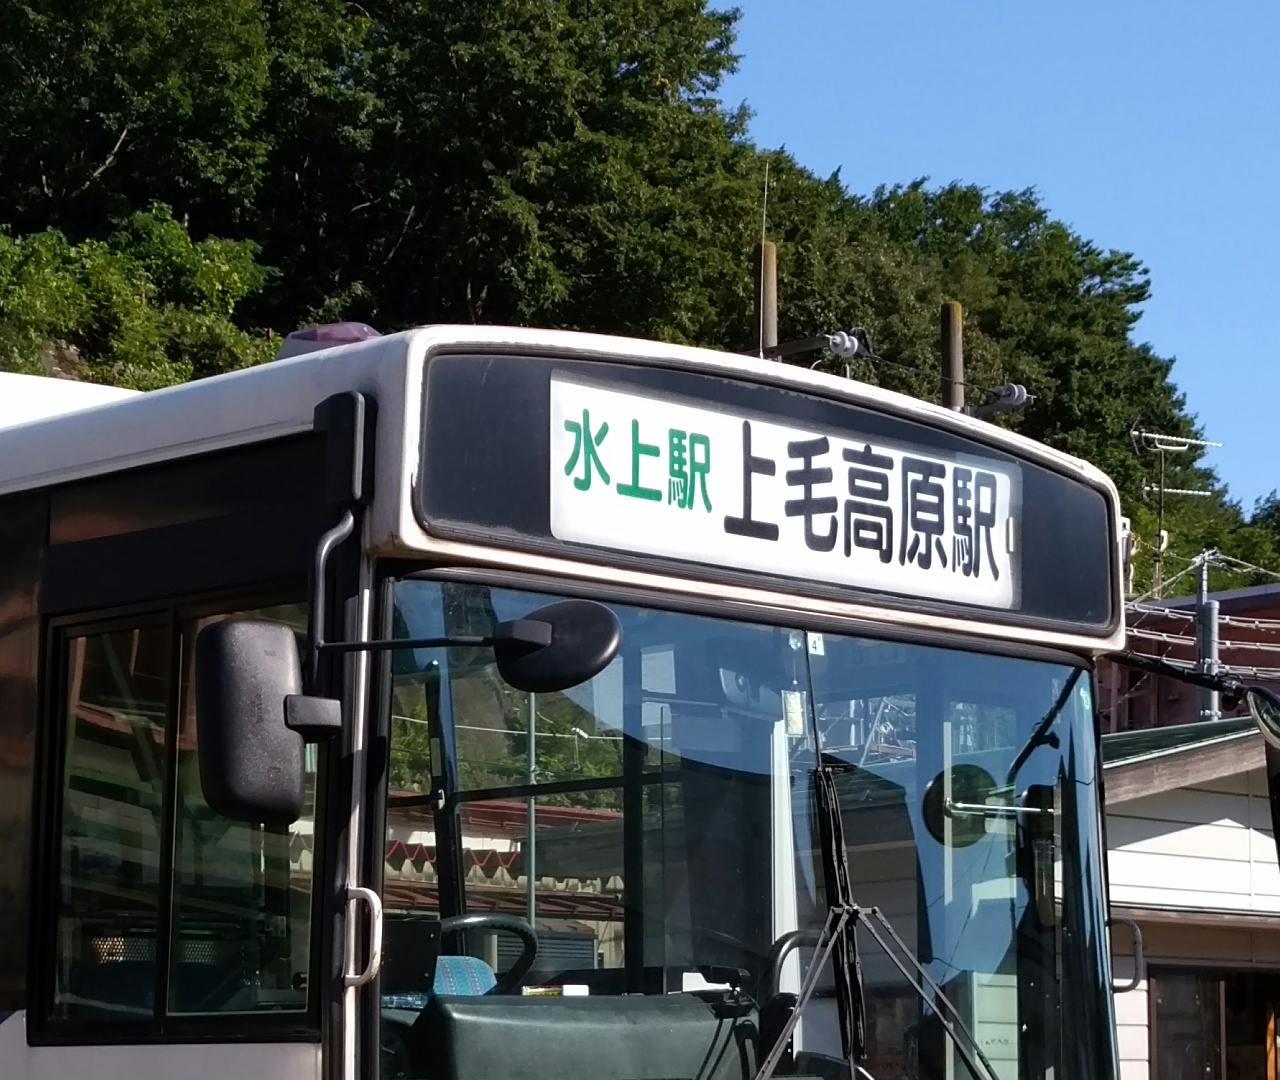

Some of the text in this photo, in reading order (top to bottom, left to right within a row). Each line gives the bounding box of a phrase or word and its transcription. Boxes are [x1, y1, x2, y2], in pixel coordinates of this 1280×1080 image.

[564, 408, 999, 581] 水上駅 上毛高原駅
